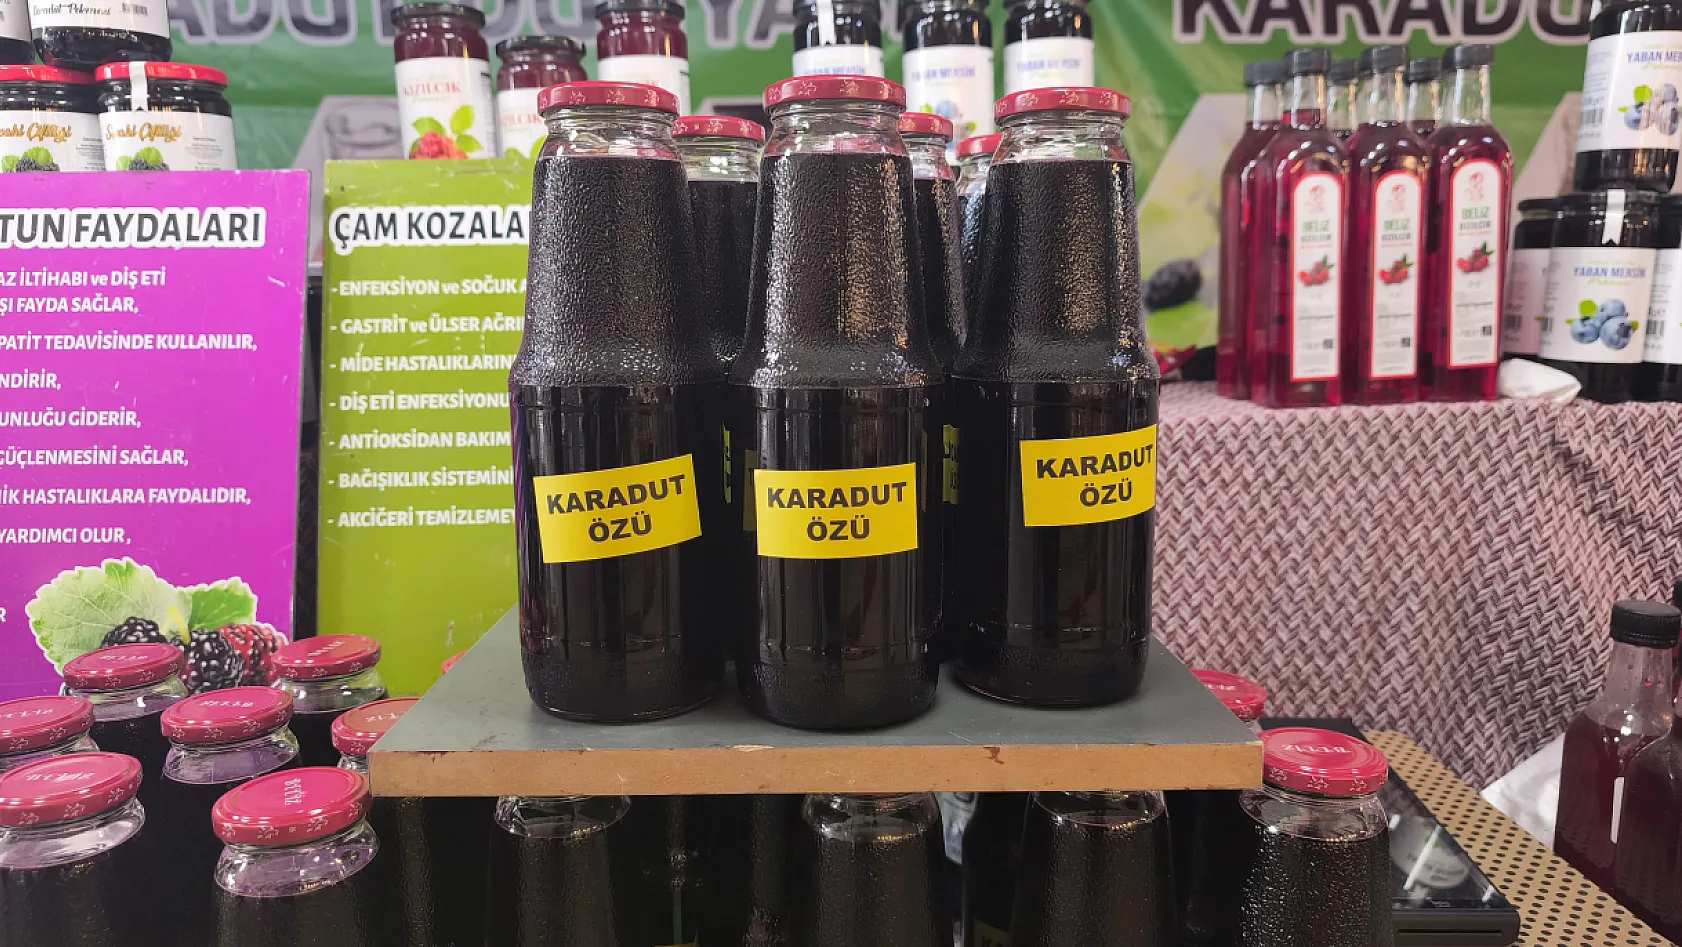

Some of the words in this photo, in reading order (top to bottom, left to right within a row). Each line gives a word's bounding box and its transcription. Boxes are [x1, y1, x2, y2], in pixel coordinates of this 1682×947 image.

[1627, 51, 1662, 63] YABAN
[75, 213, 260, 242] FAYDALARI
[335, 213, 398, 249] ÇAM
[20, 266, 88, 286] İLTİHABI
[90, 273, 108, 286] ve
[111, 266, 138, 289] DİŞ
[141, 266, 166, 286] ETİ
[1574, 266, 1608, 276] YABAN
[340, 276, 439, 296] ENFEKSİYON
[442, 282, 460, 294] ve
[462, 274, 517, 294] SOĞUK
[17, 297, 68, 312] FAYDA
[72, 292, 138, 314] SAĞLAR,
[341, 313, 408, 334] GASTRİT
[409, 321, 428, 333] ve
[430, 313, 480, 332] ÜLSER
[482, 312, 524, 332] AĞRI
[44, 330, 154, 350] TEDAVİSİNDE
[156, 333, 258, 352] KULLANILIR,
[340, 352, 384, 372] MİDE
[385, 354, 517, 371] HASTALIKLARIN
[340, 390, 368, 414] DİŞ
[370, 390, 394, 410] ETİ
[68, 406, 141, 428] GİDERİR,
[339, 428, 453, 450] ANTİOKSİDAN
[120, 445, 188, 466] SAĞLAR,
[1036, 444, 1154, 479] KARADUT
[338, 468, 430, 492] BAĞIŞIKLIK
[0, 484, 19, 504] İK
[22, 488, 146, 505] HASTALIKLARA
[148, 486, 251, 505] FAYDALIDIR,
[547, 474, 686, 514] KARADUT
[767, 482, 908, 509] KARADUT
[1079, 477, 1132, 508] ÖZÜ
[337, 506, 414, 527] AKCİĞERİ
[588, 511, 652, 544] ÖZÜ
[0, 528, 76, 544] YARDIMCI
[806, 514, 870, 542] ÖZÜ
